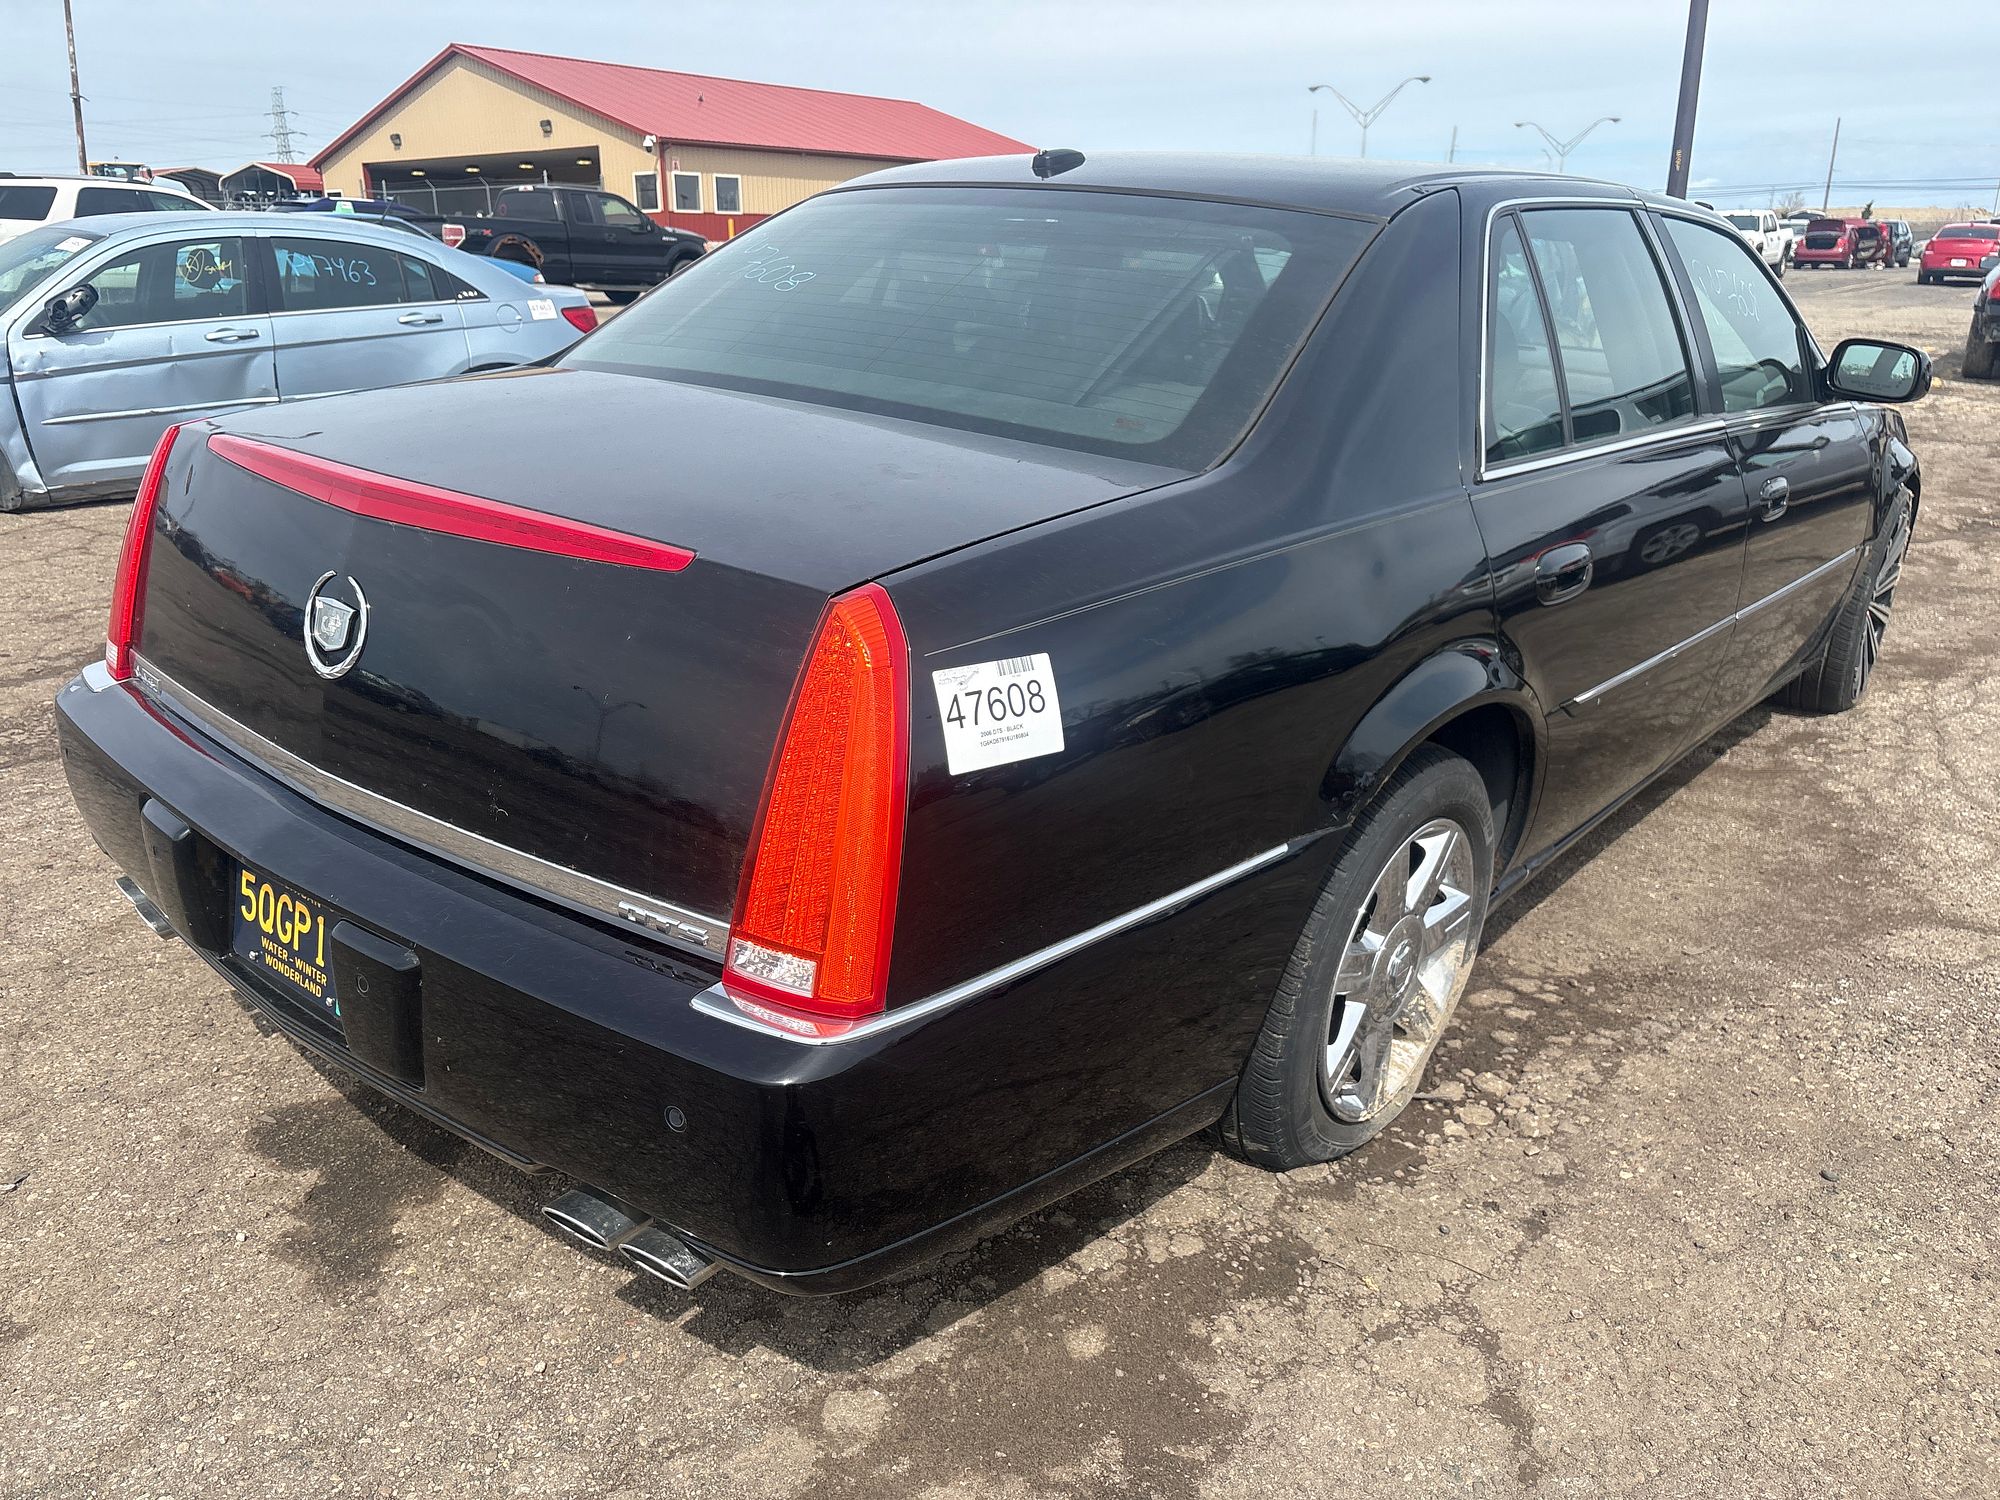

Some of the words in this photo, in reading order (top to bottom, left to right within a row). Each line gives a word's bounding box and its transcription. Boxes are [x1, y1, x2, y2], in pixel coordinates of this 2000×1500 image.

[946, 679, 1046, 729] 47608
[1007, 723, 1024, 732] BLACK
[240, 869, 326, 968] 5QGP1
[264, 952, 322, 998] WONDERLAND
